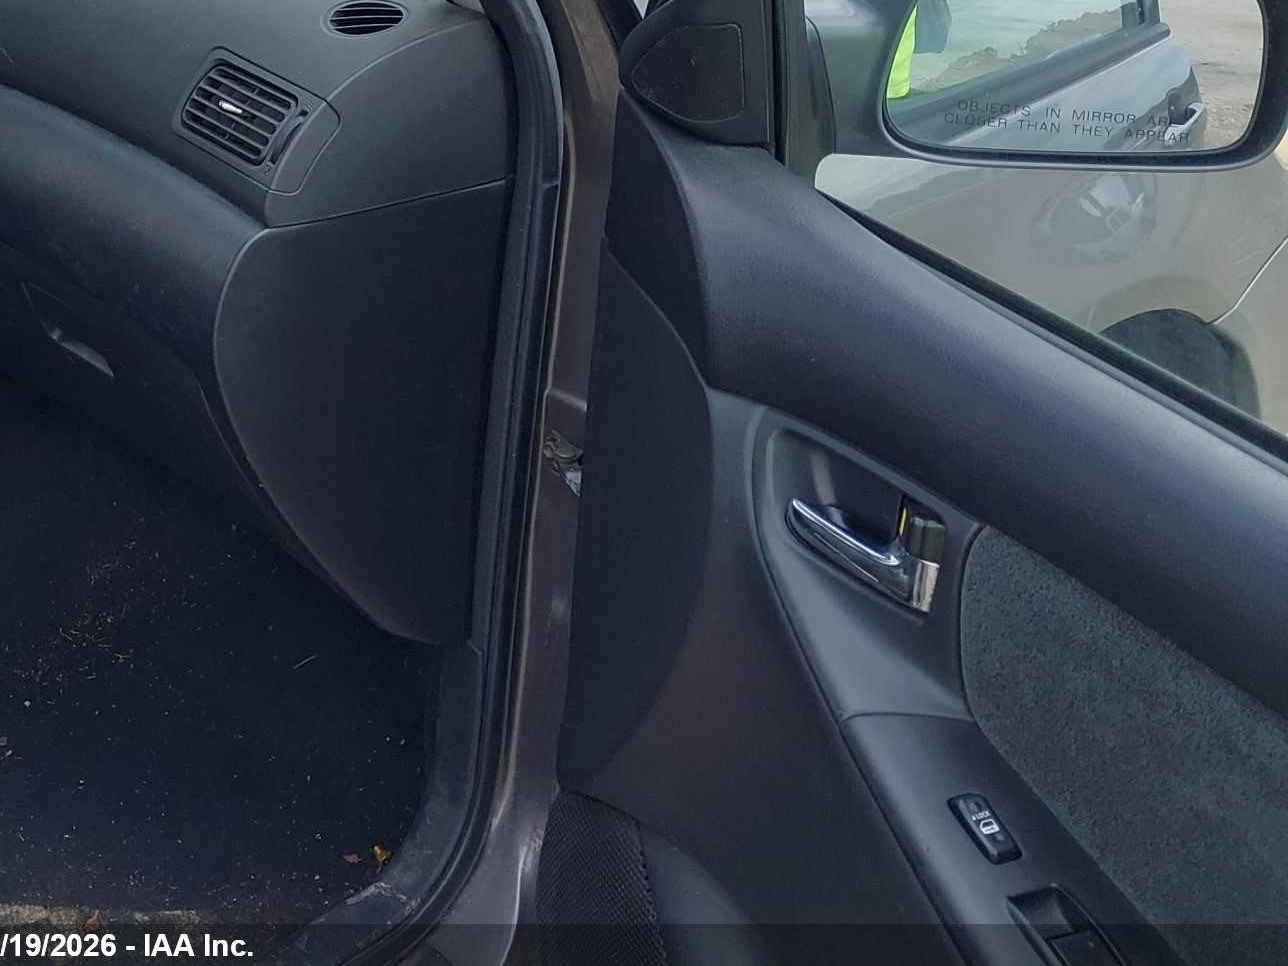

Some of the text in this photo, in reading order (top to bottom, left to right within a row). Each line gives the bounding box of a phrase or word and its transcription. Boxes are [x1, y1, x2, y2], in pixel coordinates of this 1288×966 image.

[957, 99, 1031, 116] OBJECTS
[1045, 106, 1061, 119] IN
[1072, 109, 1137, 124] MIRROR
[944, 113, 1007, 129] CLOSER
[1017, 119, 1060, 133] THAN
[1072, 123, 1114, 137] THEY
